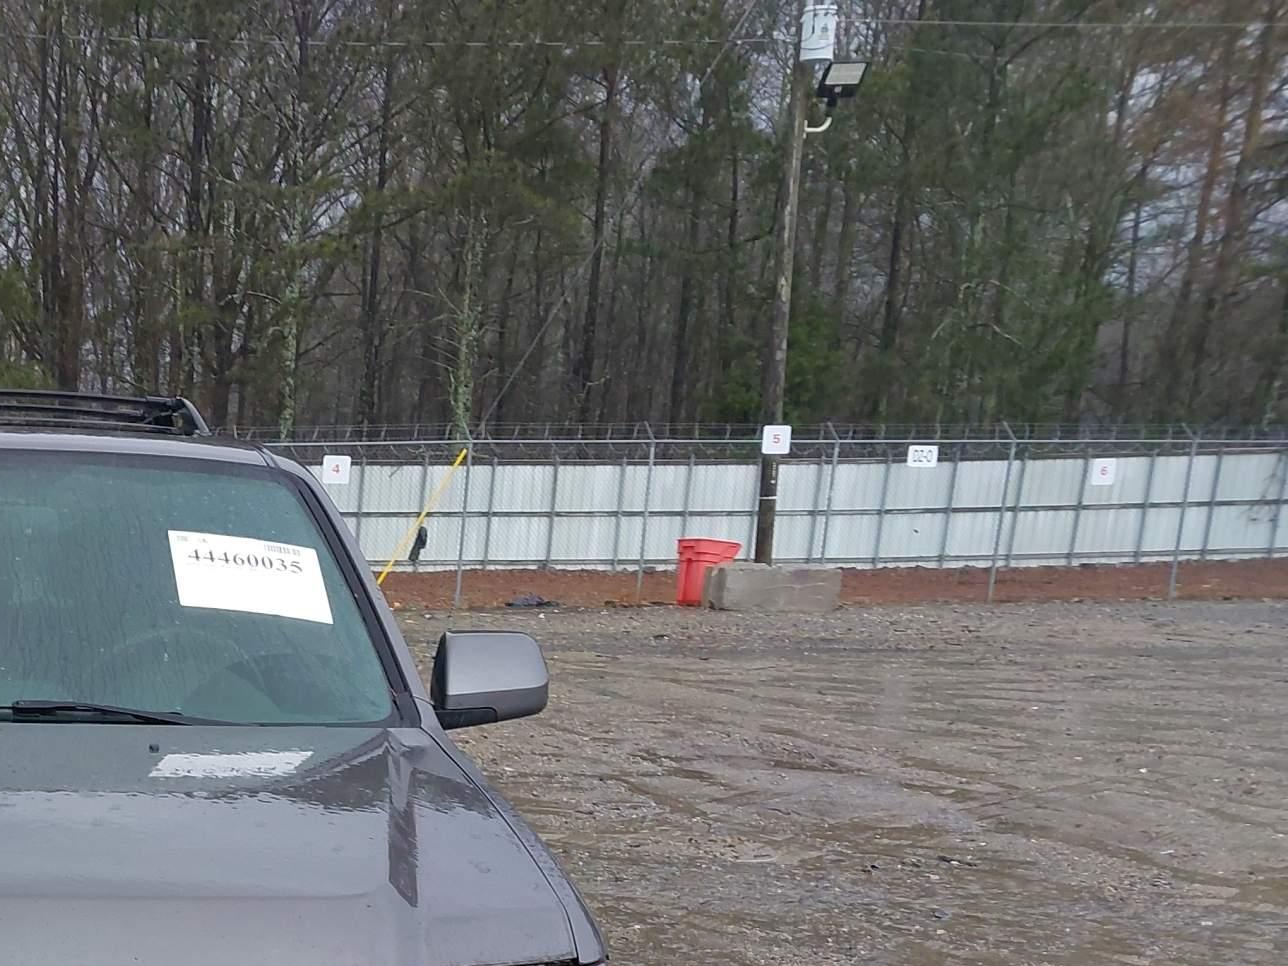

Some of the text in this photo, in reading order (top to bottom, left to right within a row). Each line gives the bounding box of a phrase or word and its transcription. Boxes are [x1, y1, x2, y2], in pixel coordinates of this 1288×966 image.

[773, 433, 781, 444] 5
[332, 464, 340, 474] 4
[1101, 465, 1108, 476] 6
[188, 548, 304, 575] 44460035
